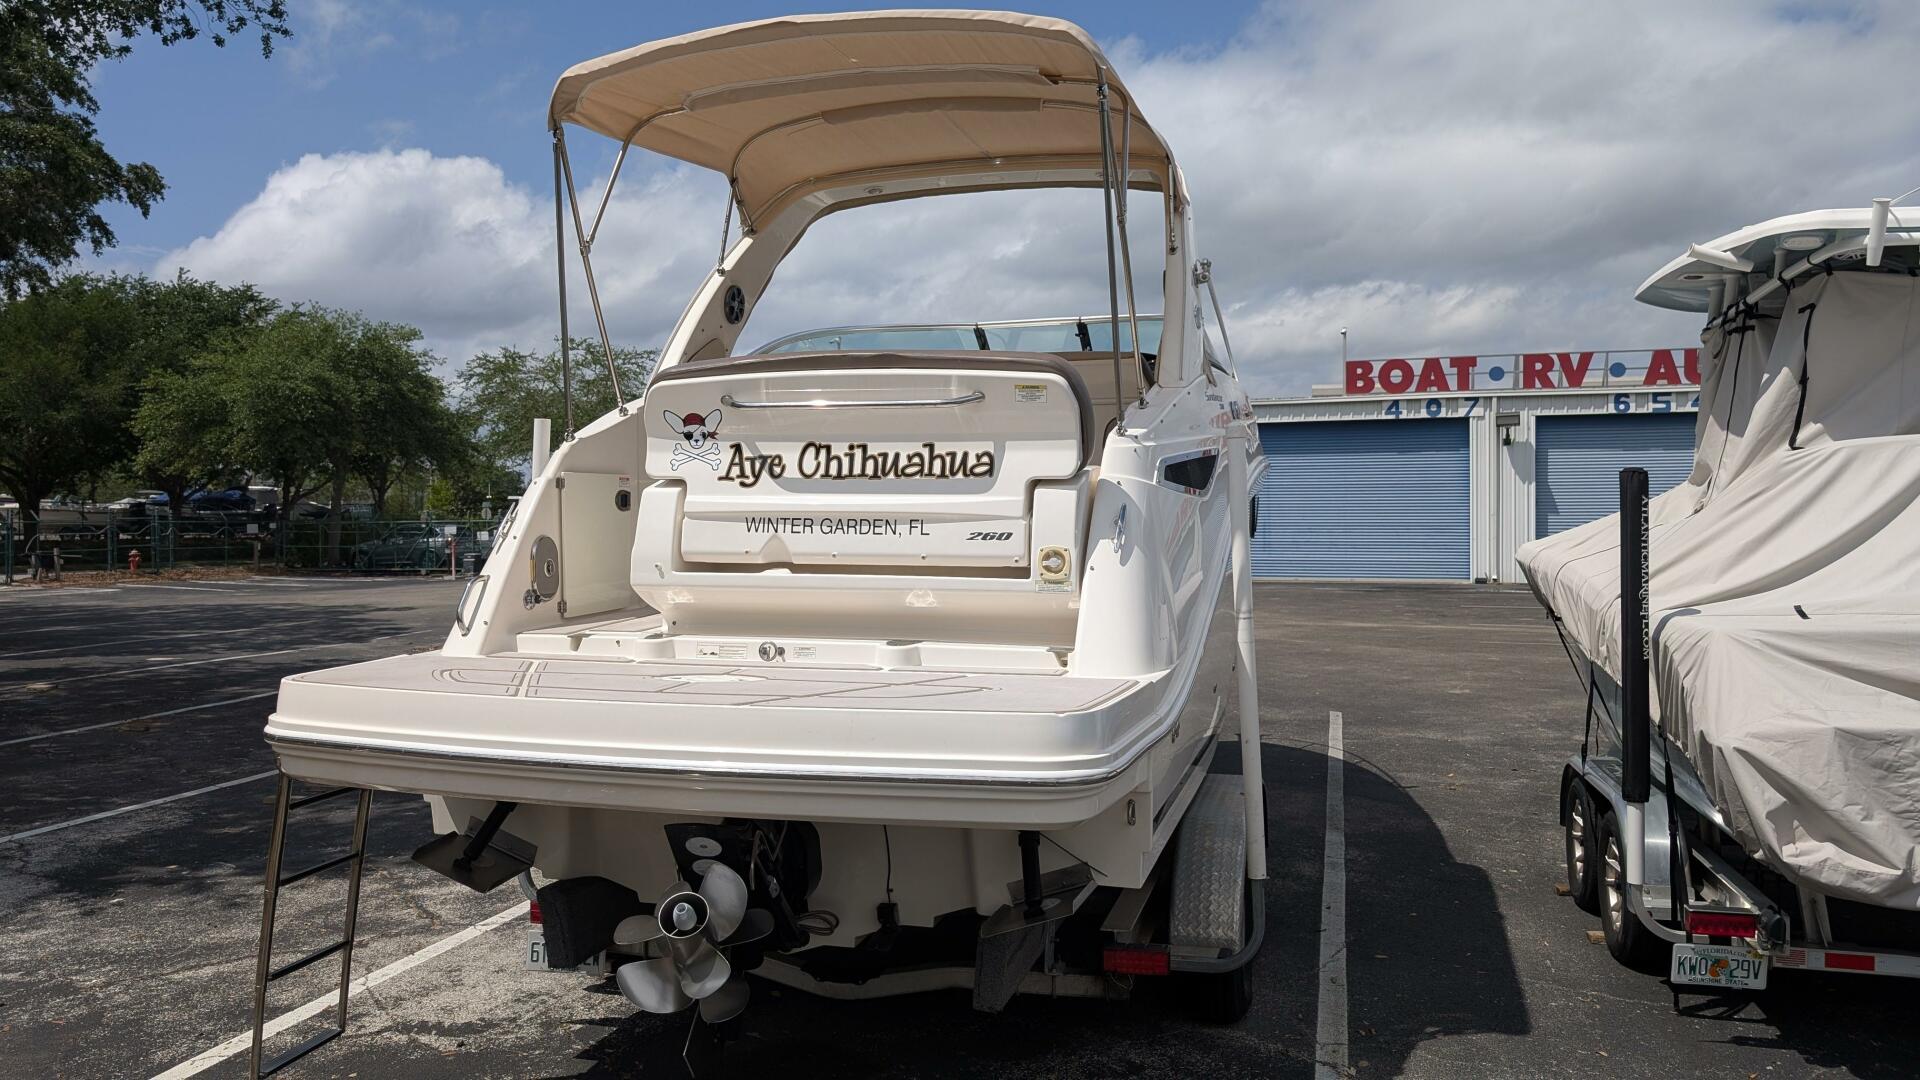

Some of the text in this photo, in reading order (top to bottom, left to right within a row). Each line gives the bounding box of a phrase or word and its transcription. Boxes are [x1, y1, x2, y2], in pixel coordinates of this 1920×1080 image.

[1345, 356, 1477, 394] BOAT
[1523, 352, 1594, 389] RV
[1385, 397, 1479, 418] 407
[718, 440, 995, 488] Aye Chihuahua
[745, 517, 930, 538] WINTER GARDEN, FL
[966, 531, 1014, 541] 260
[1730, 959, 1762, 980] 29V
